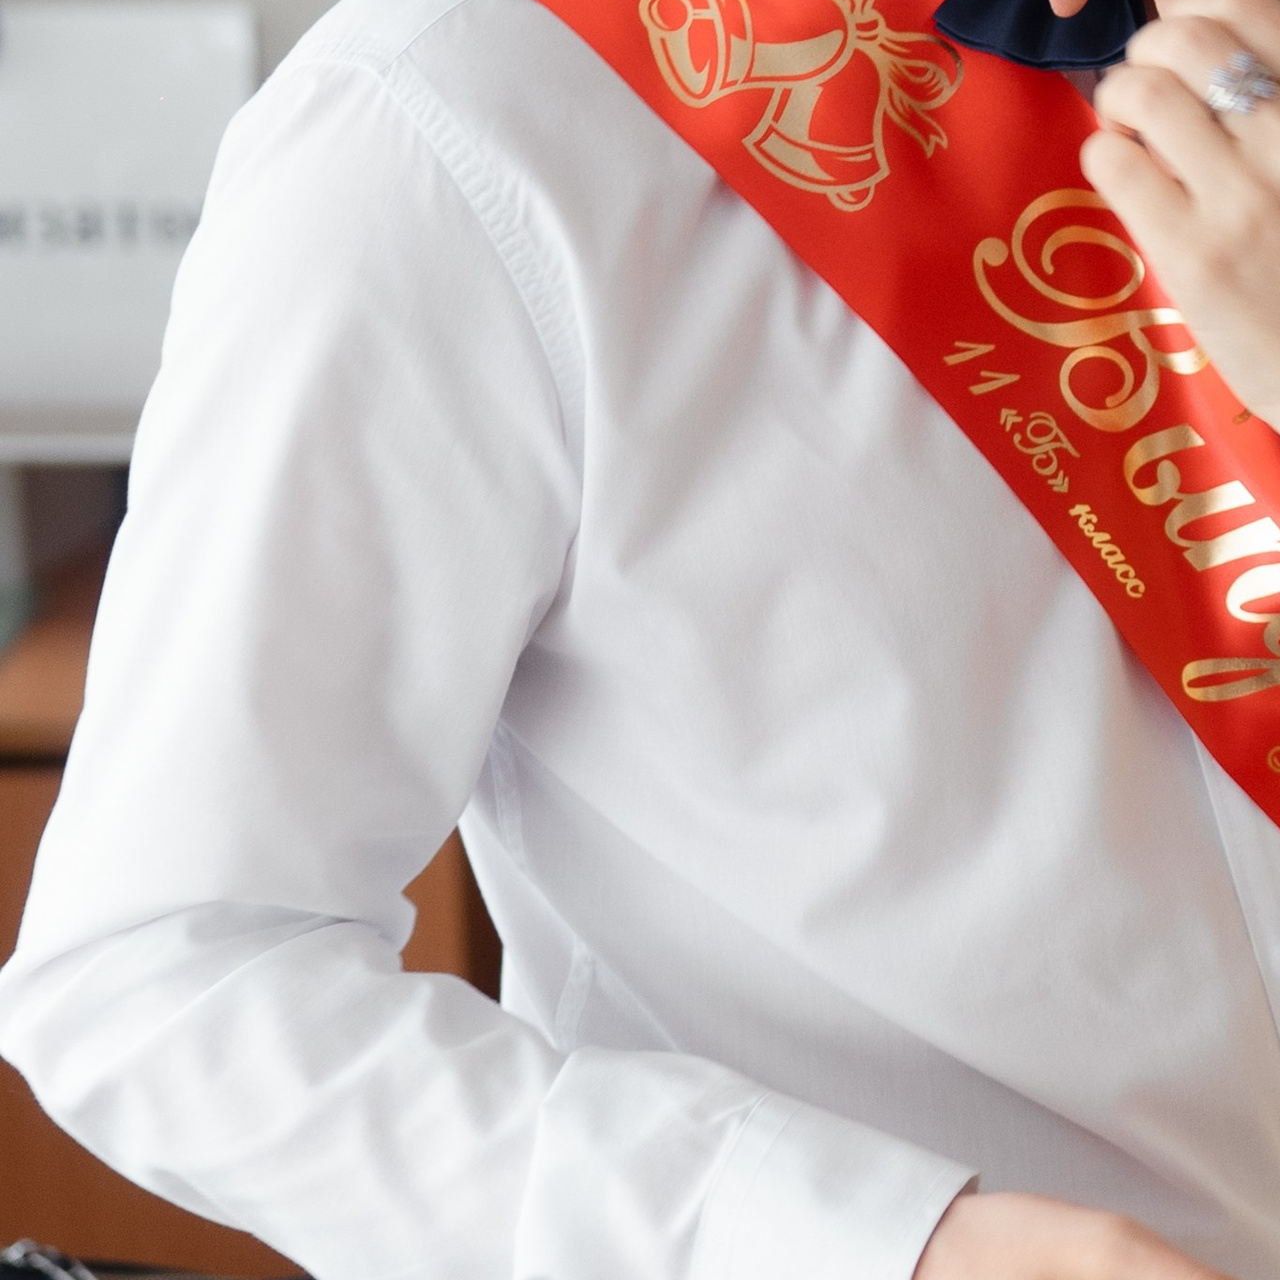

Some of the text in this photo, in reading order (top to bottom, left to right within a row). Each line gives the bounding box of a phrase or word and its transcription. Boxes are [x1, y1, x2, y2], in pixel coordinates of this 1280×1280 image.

[943, 340, 1146, 599] 11 «Б» класс
